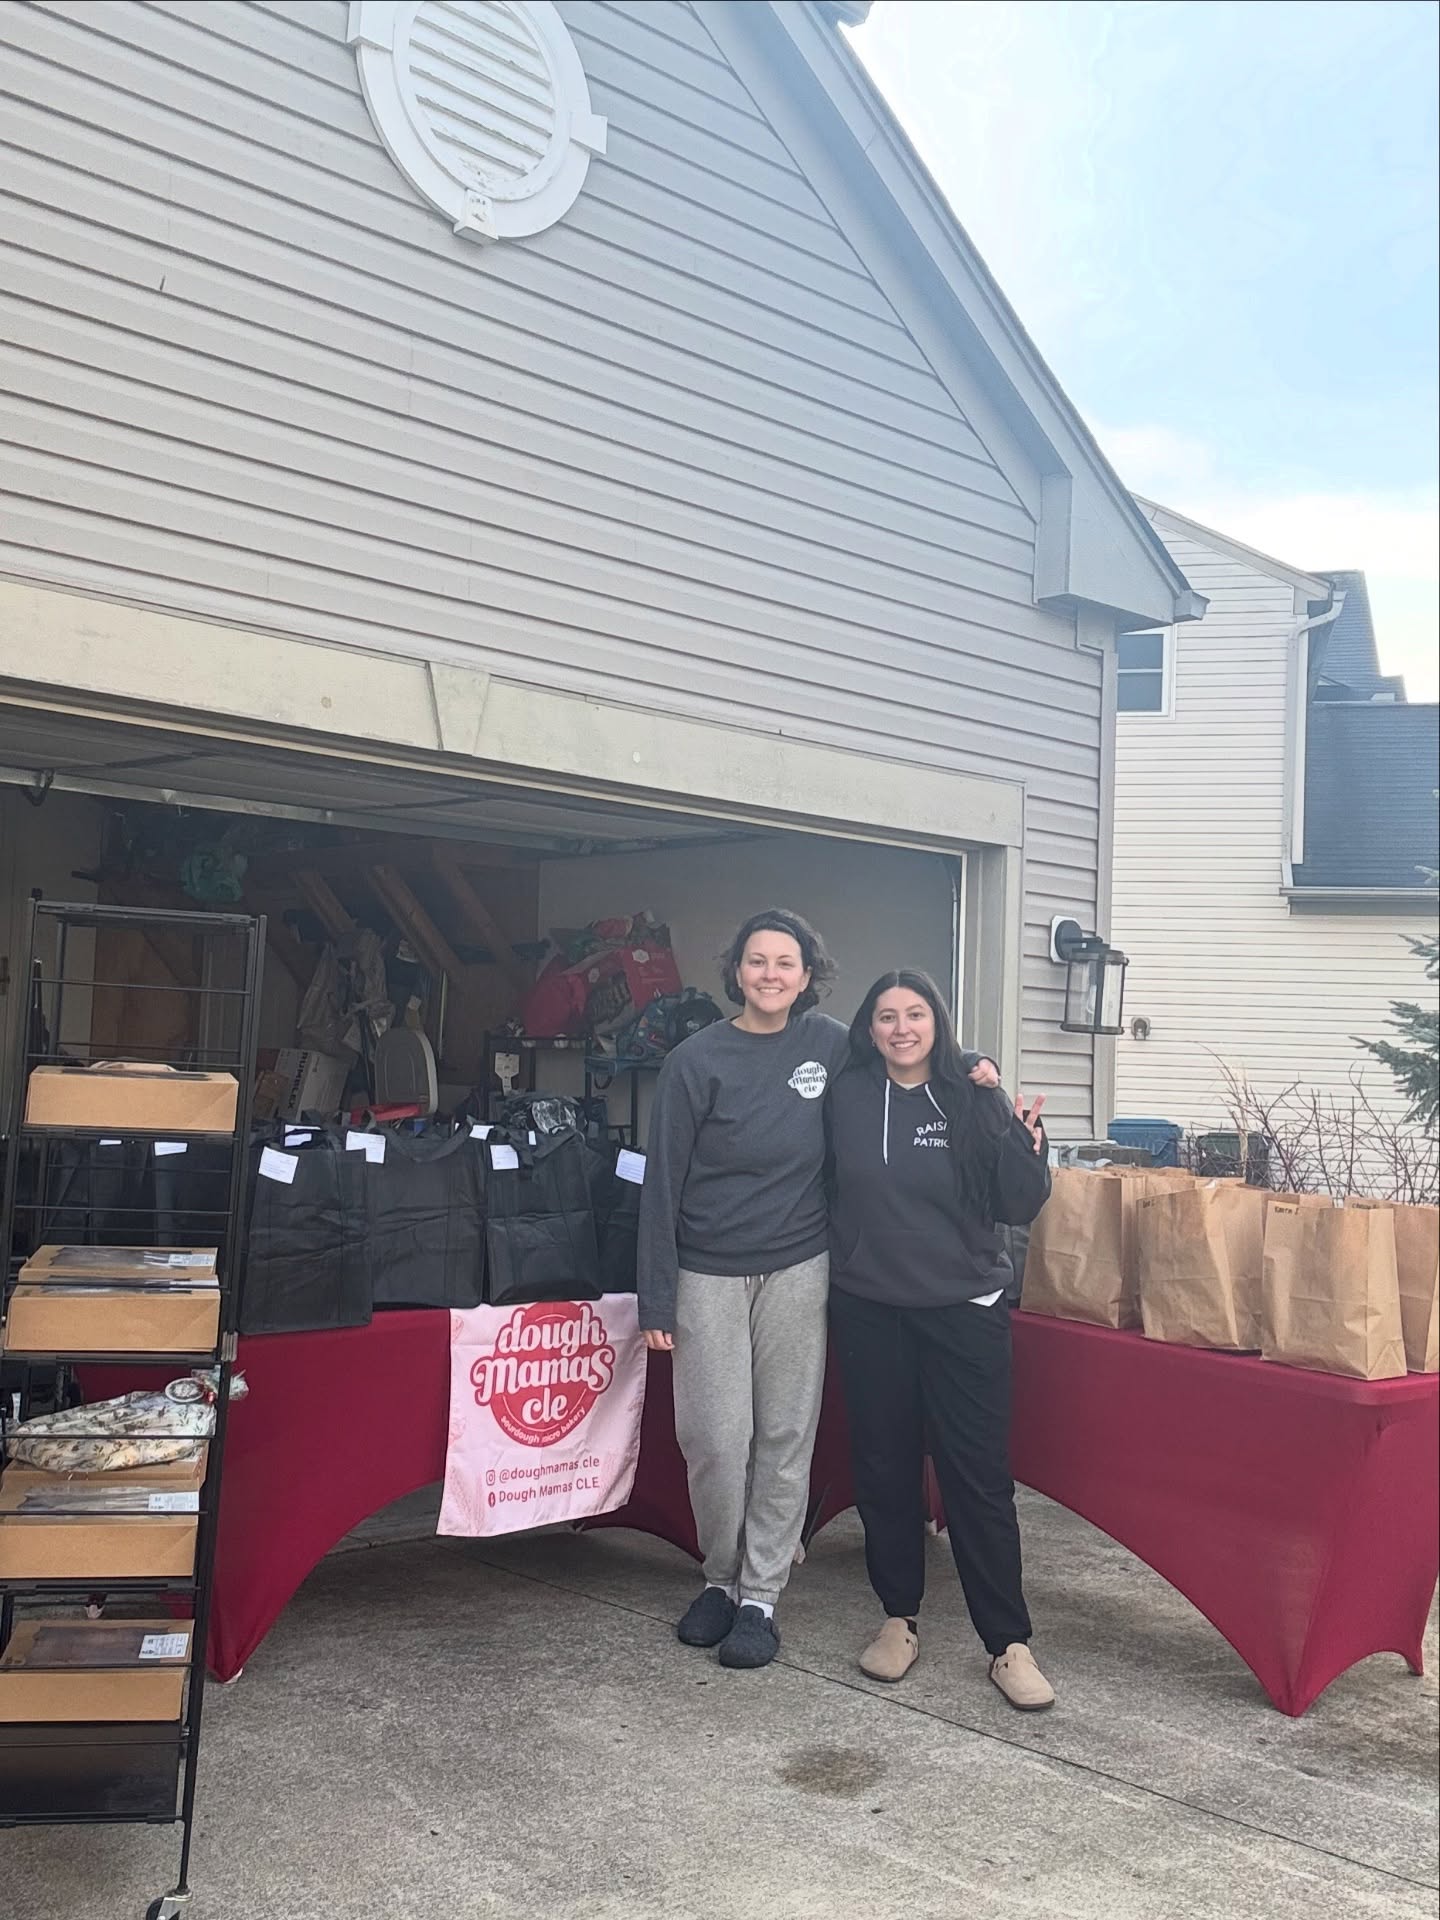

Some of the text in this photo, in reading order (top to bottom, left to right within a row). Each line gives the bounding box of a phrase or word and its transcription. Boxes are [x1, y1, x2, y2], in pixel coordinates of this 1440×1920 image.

[794, 1063, 824, 1077] dough
[499, 1304, 605, 1356] dough
[522, 1387, 569, 1425] cle
[501, 1405, 586, 1444] sourdough micro bakery
[499, 1456, 600, 1481] @doughmamas.cle
[499, 1476, 601, 1503] Dough Mamas CLE
